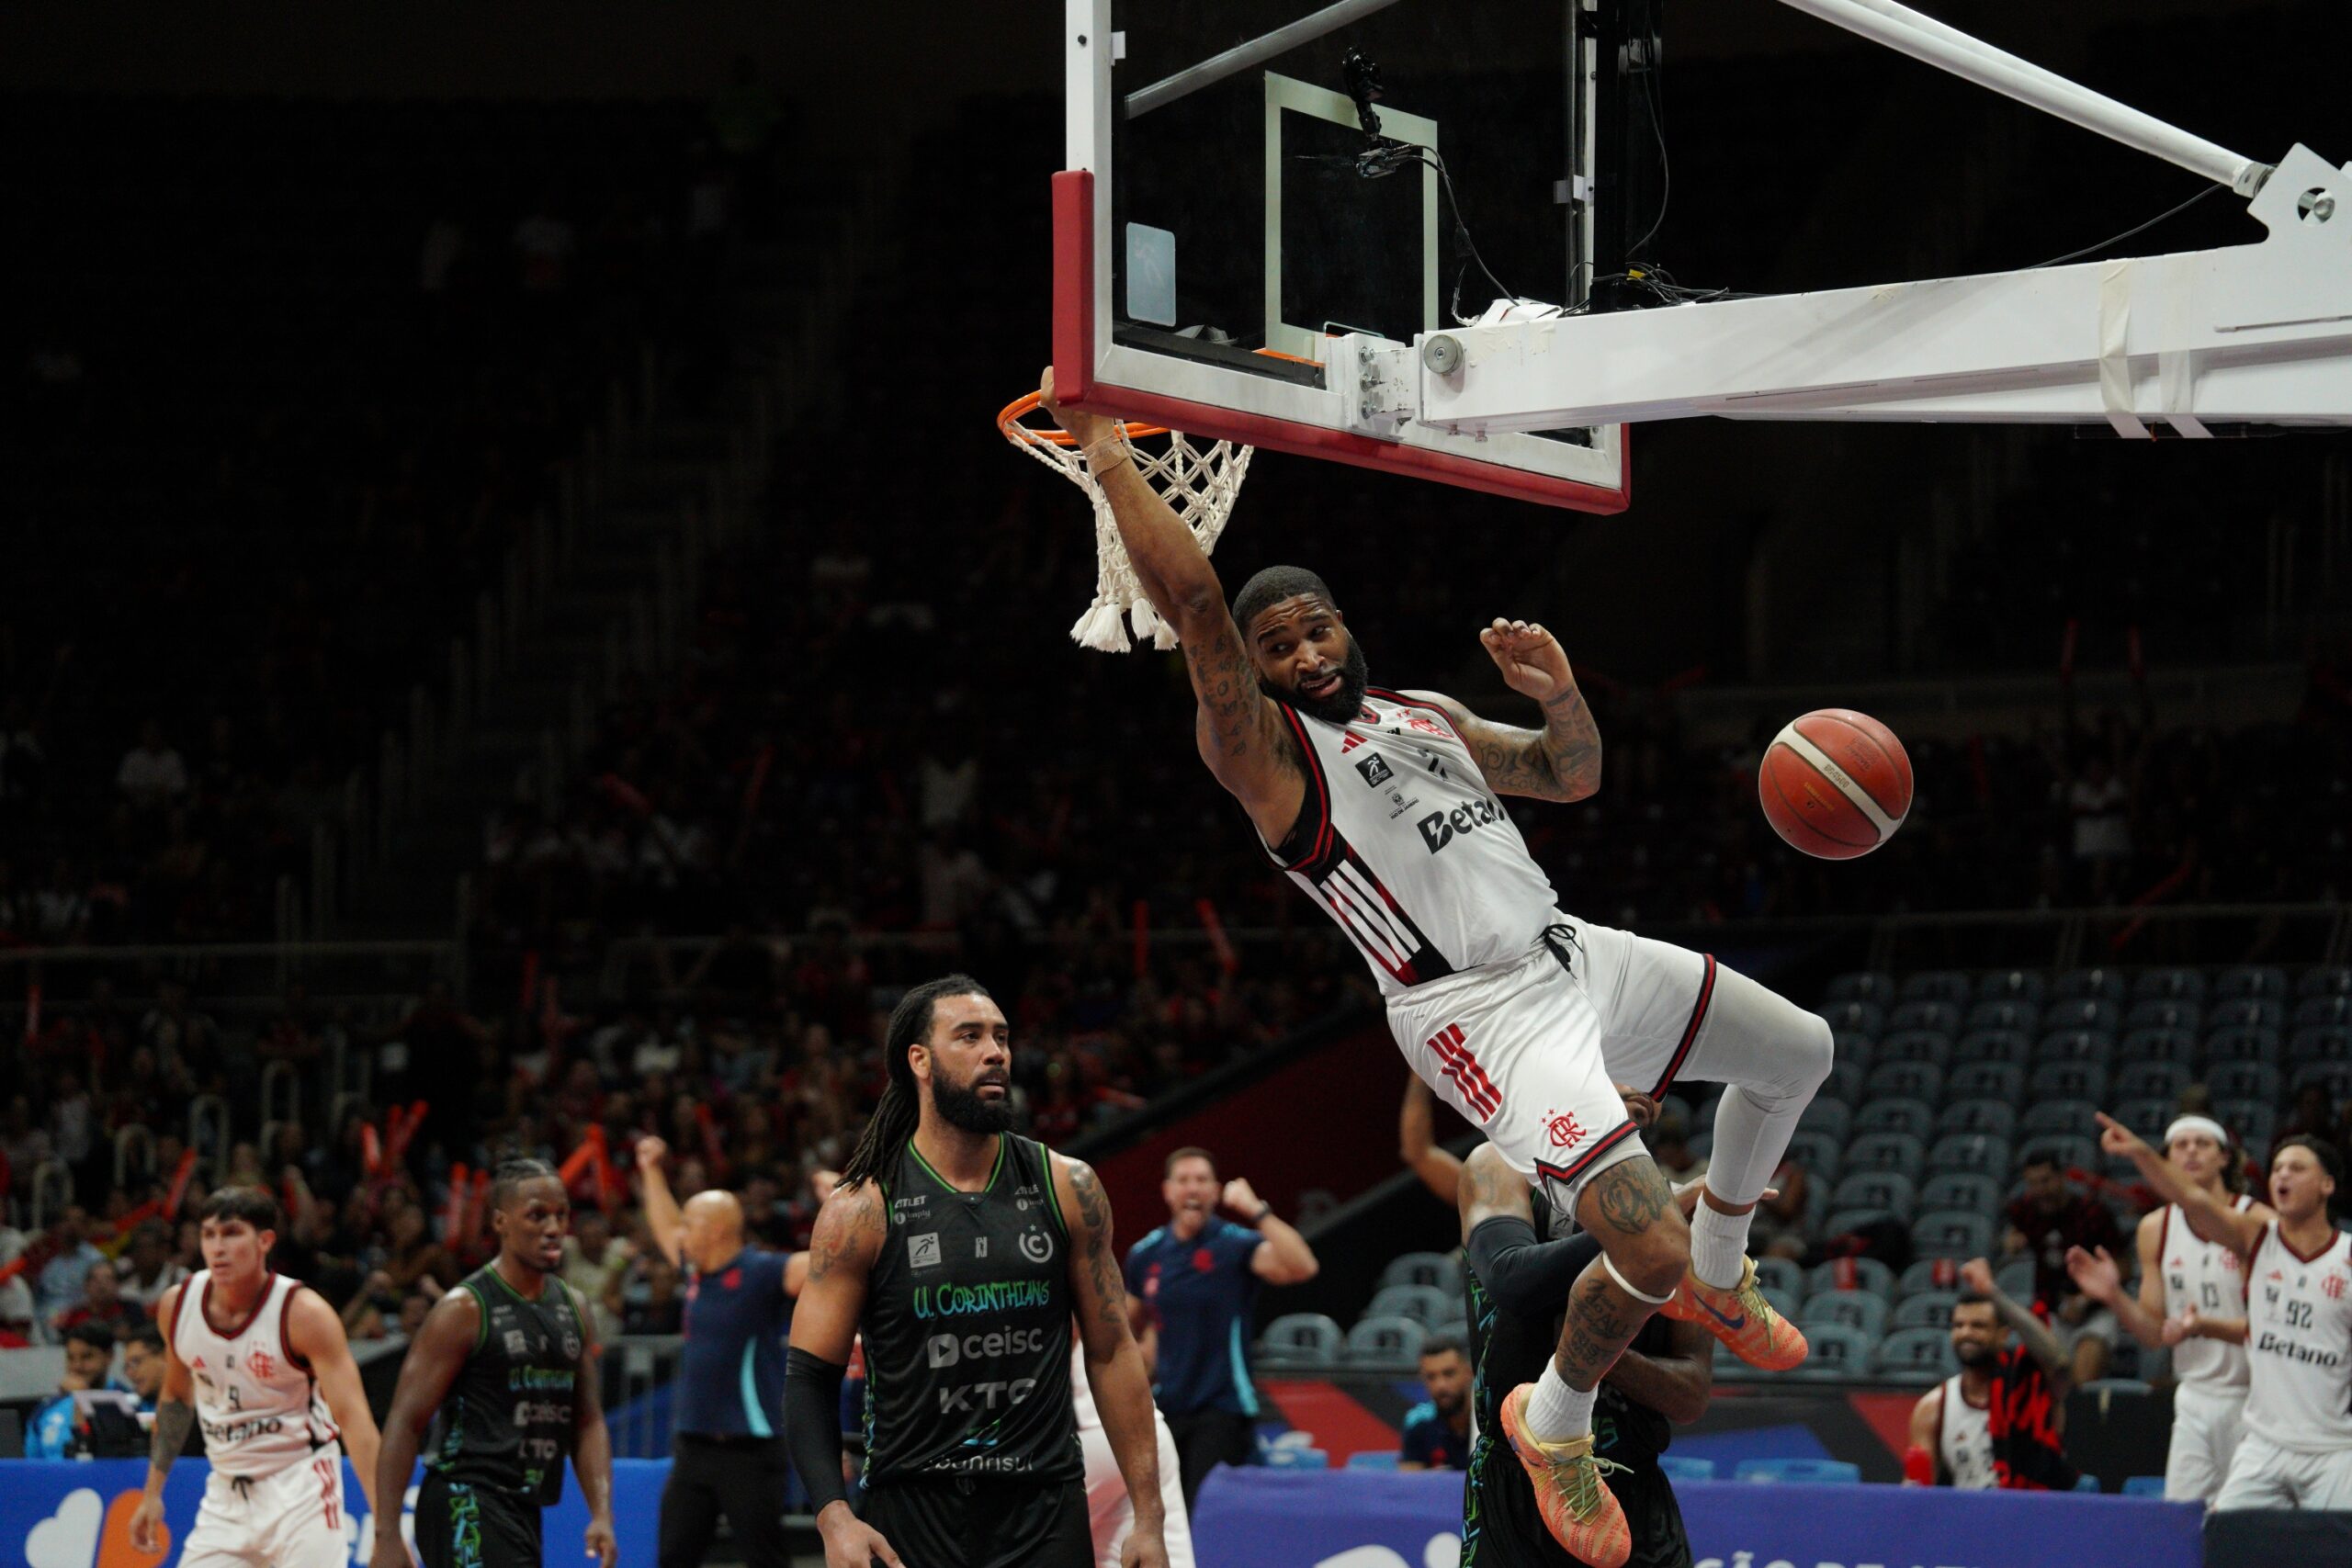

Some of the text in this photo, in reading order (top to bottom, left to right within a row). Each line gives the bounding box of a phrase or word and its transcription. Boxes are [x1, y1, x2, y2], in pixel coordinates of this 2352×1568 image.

[937, 1280, 1050, 1315] CORINTHIANS
[2286, 1299, 2312, 1329] 92
[963, 1325, 1044, 1359] ceisc
[2259, 1331, 2338, 1367] Betano
